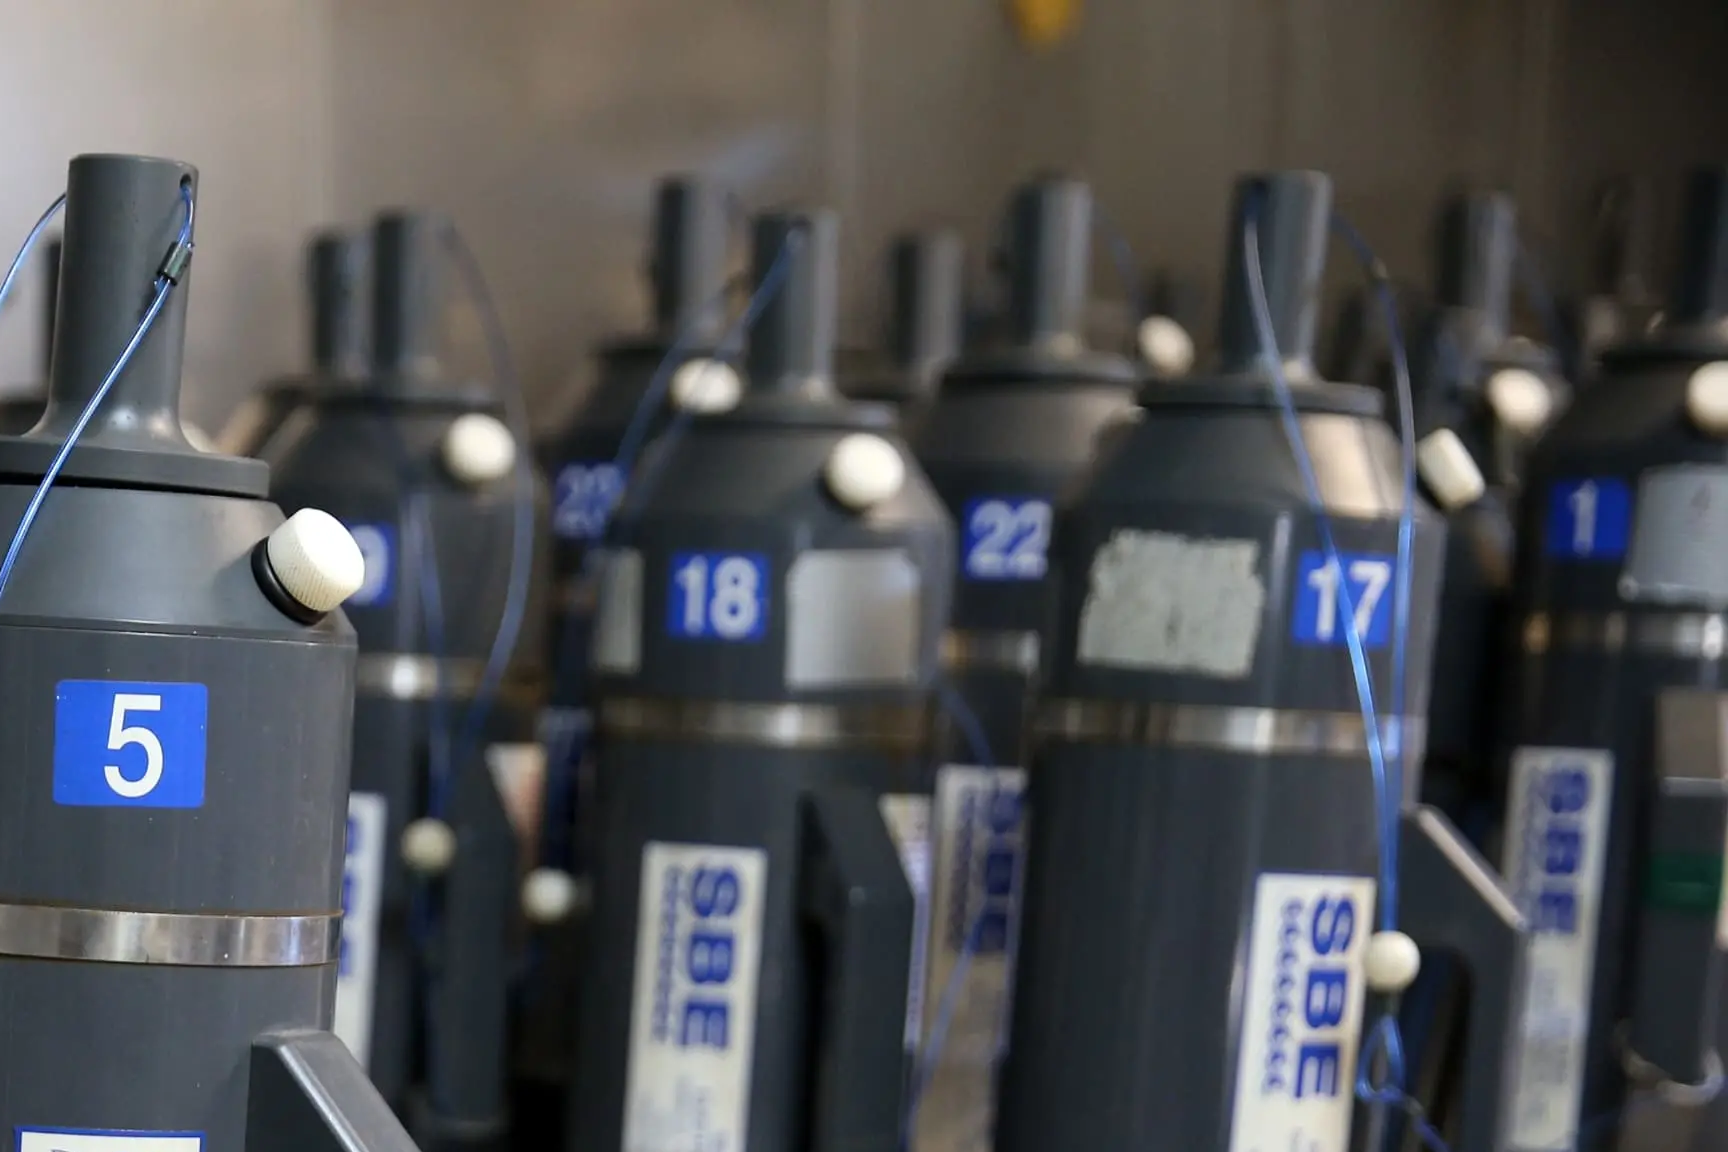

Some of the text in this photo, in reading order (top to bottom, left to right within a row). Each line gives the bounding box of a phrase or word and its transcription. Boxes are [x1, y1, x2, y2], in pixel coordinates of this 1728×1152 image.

[969, 500, 1051, 576] 22
[677, 555, 760, 639] 18
[1308, 557, 1391, 641] 17
[104, 693, 163, 798] 5
[681, 866, 740, 1048] SBE
[1295, 893, 1357, 1100] SBE
